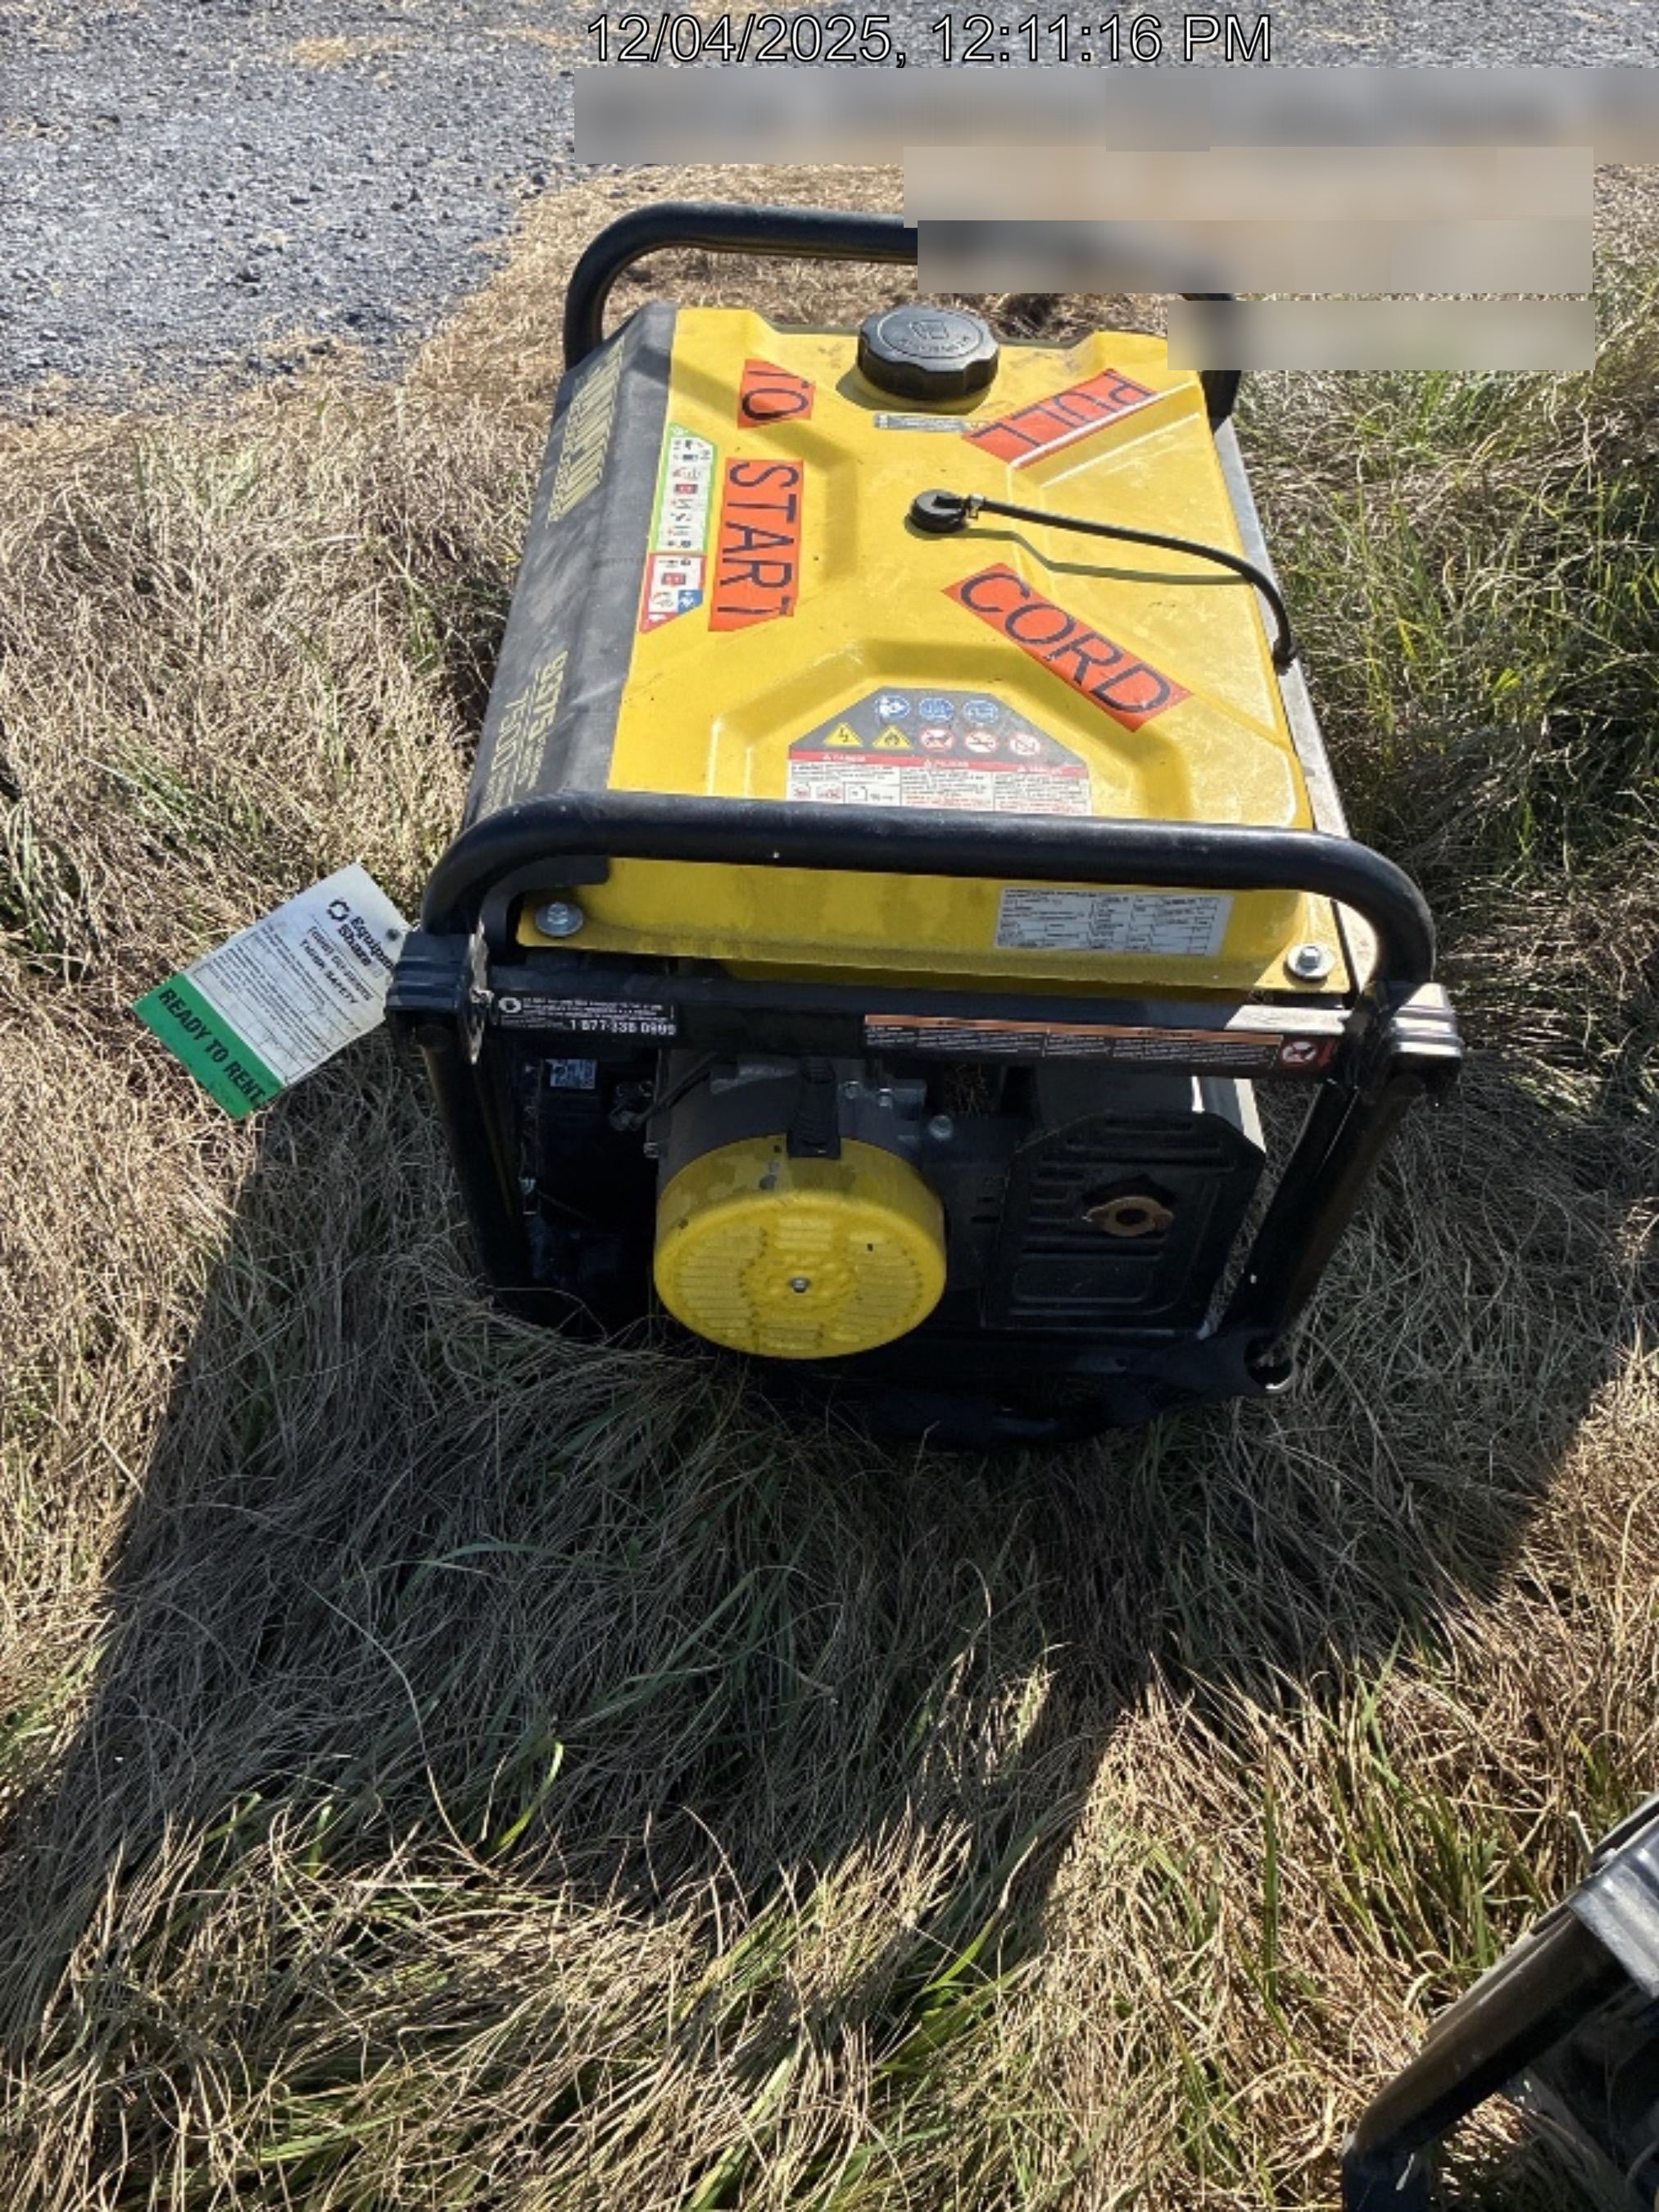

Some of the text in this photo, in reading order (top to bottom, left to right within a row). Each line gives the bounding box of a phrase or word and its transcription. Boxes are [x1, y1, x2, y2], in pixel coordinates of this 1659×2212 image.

[970, 369, 1158, 449] PULL
[716, 460, 800, 615] START
[959, 572, 1172, 714] CORD
[337, 923, 372, 967] Share
[158, 988, 266, 1105] READY TO RENT
